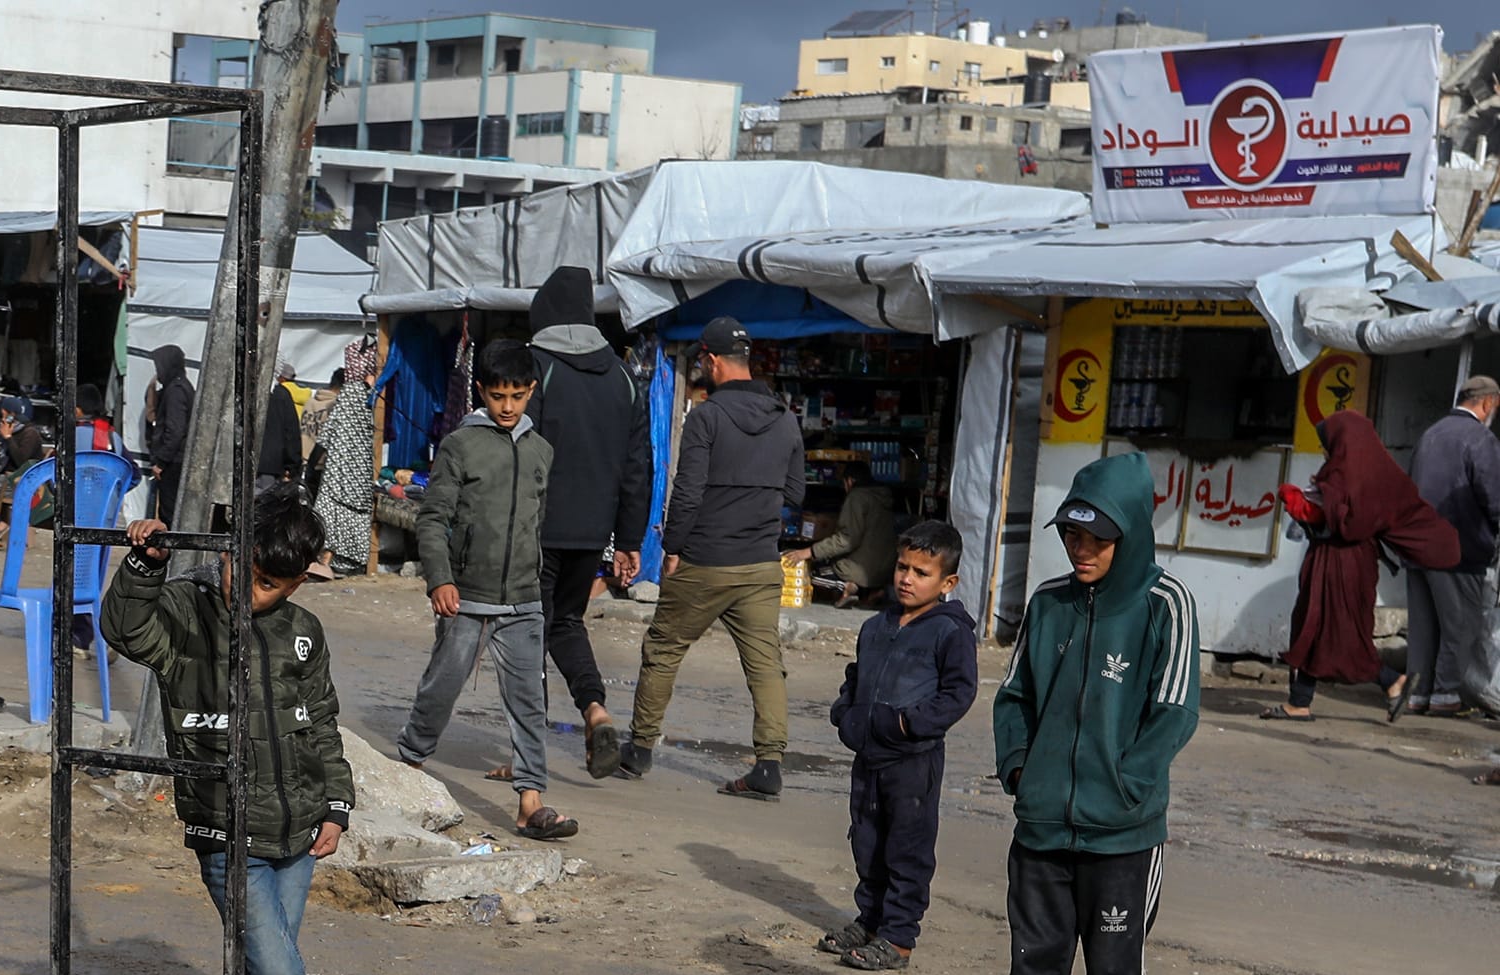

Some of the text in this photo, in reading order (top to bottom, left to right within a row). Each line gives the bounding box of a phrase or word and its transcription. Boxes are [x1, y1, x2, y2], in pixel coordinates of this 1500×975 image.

[1101, 110, 1412, 157] صيدلية الوداد
[1338, 164, 1354, 175] عبد
[1282, 190, 1304, 202] خدمة
[1195, 463, 1276, 527] صيدلية
